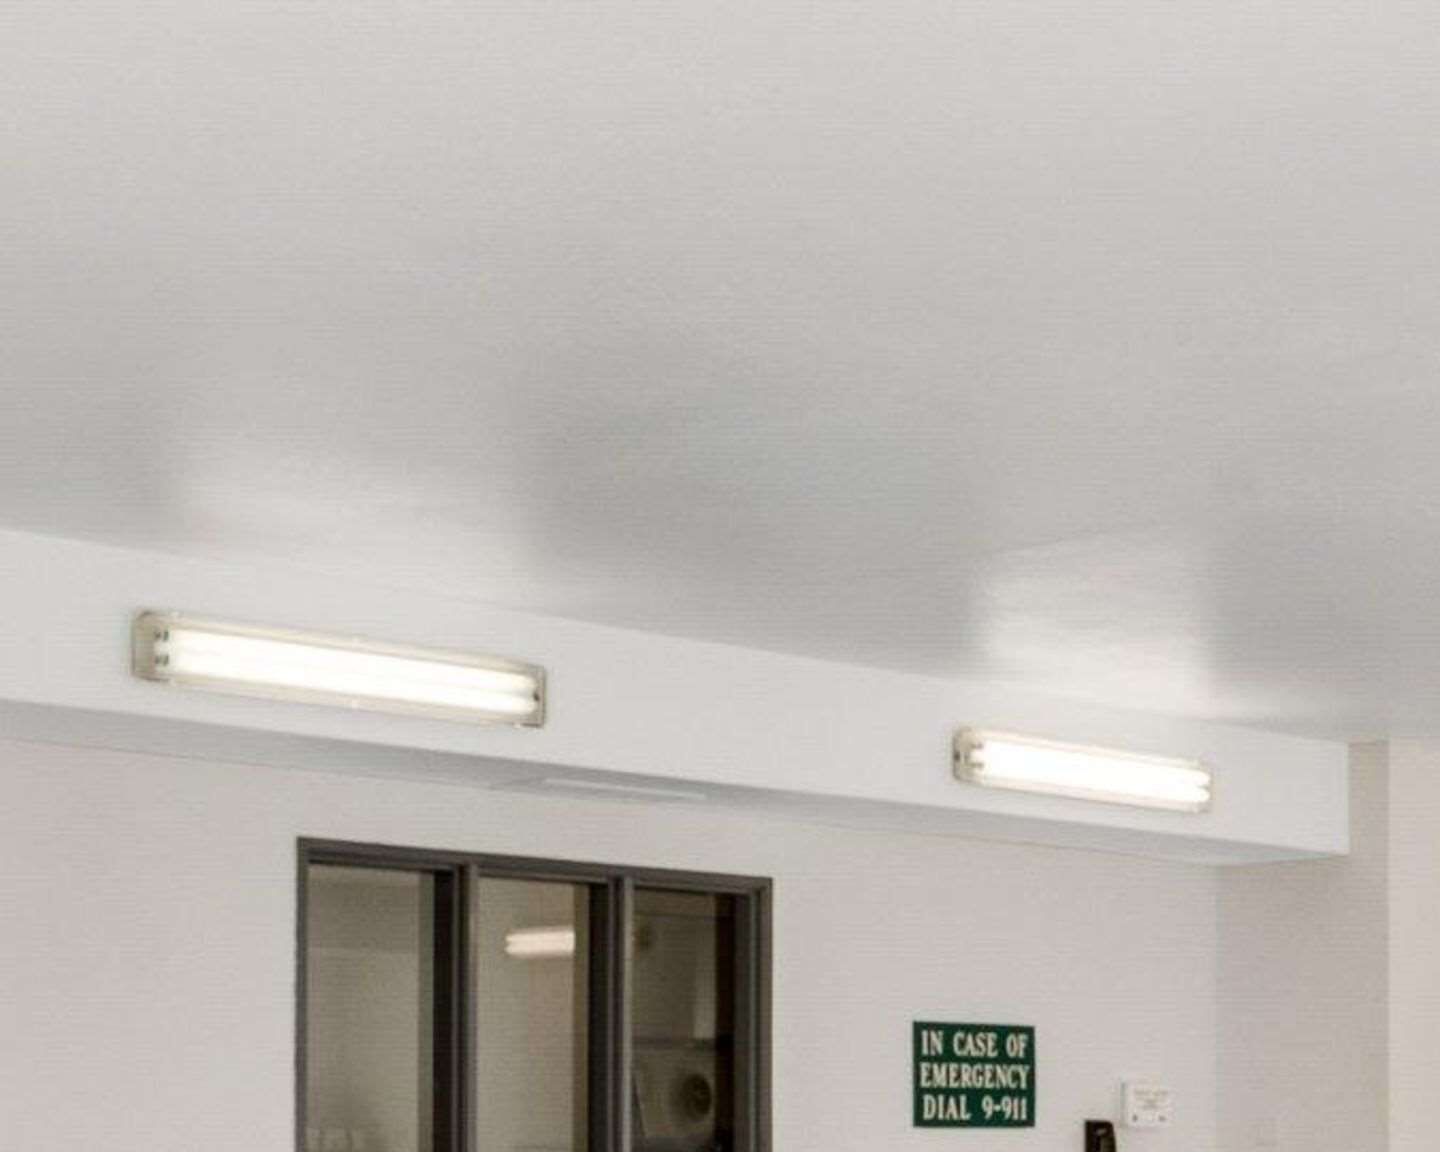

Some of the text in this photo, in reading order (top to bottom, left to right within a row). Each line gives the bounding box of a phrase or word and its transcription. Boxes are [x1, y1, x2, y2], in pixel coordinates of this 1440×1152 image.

[921, 1029, 1028, 1059] IN CASE OF
[919, 1061, 1030, 1089] EMERGENCY
[923, 1094, 1027, 1121] DIAL 9-911
